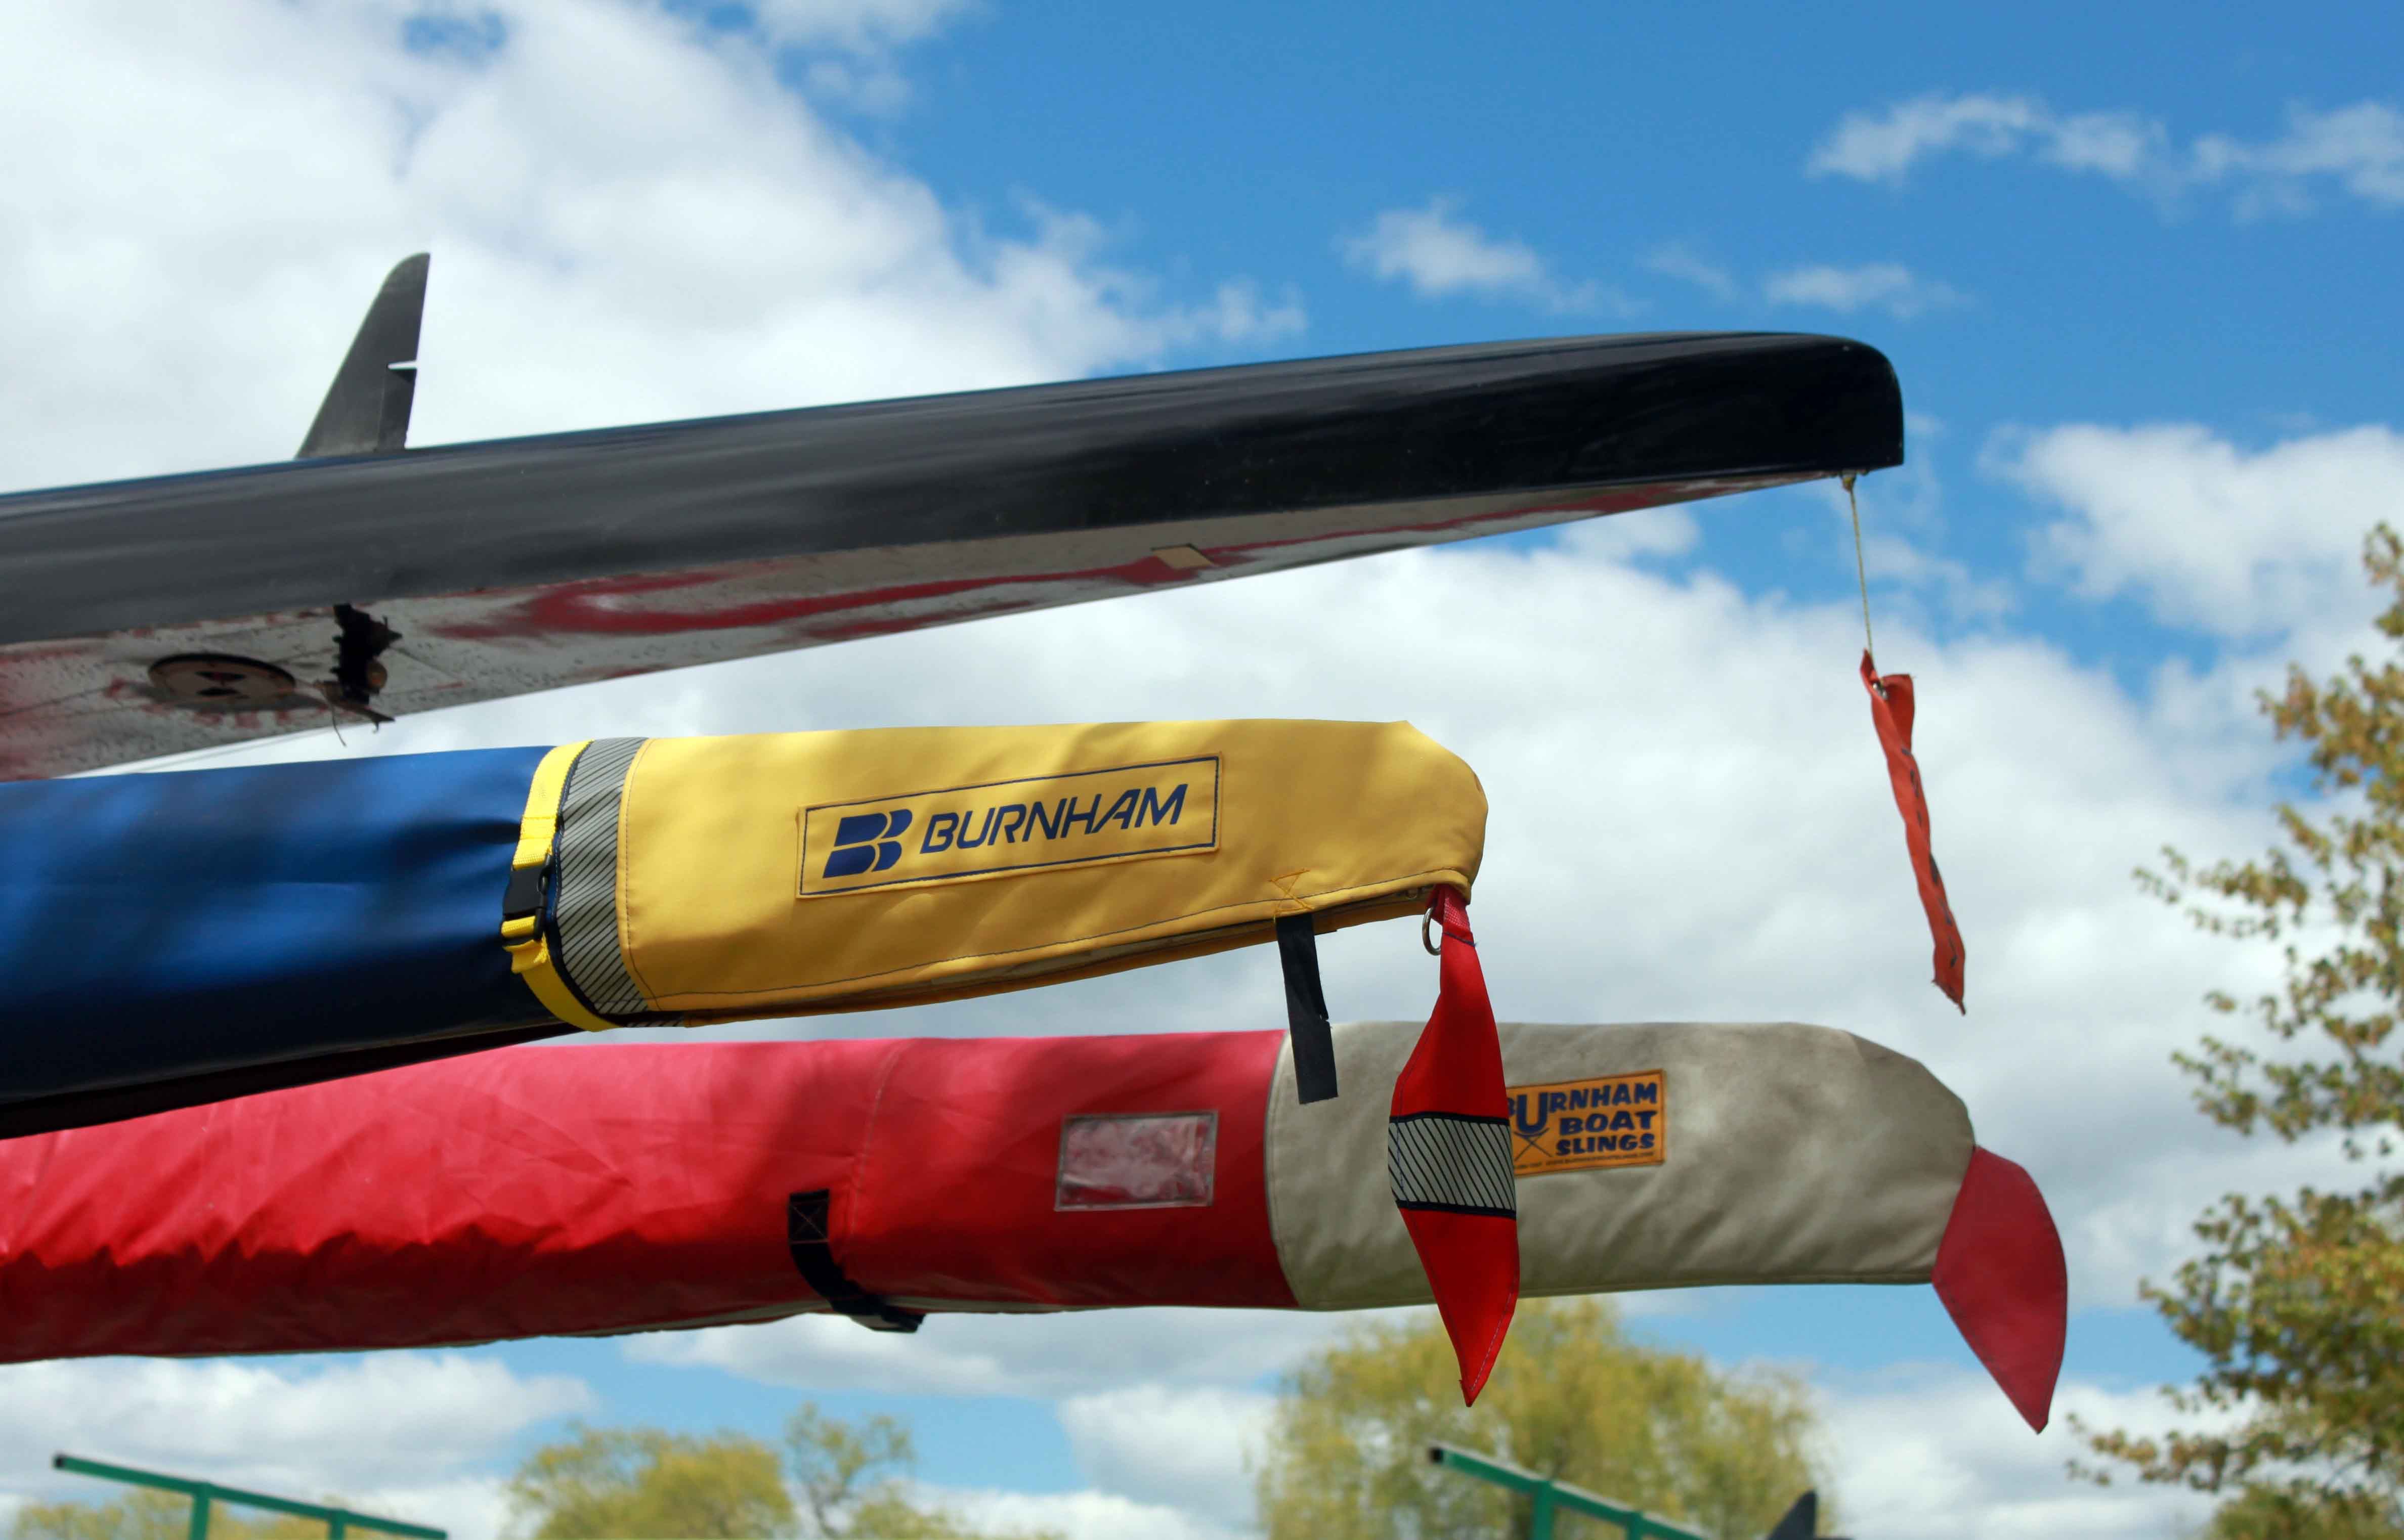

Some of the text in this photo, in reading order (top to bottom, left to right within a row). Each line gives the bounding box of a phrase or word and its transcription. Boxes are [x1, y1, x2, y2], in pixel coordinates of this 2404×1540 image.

[920, 783, 1188, 854] BURNHAM
[1559, 1110, 1658, 1136] BOAT
[1556, 1133, 1655, 1156] SLINGS
